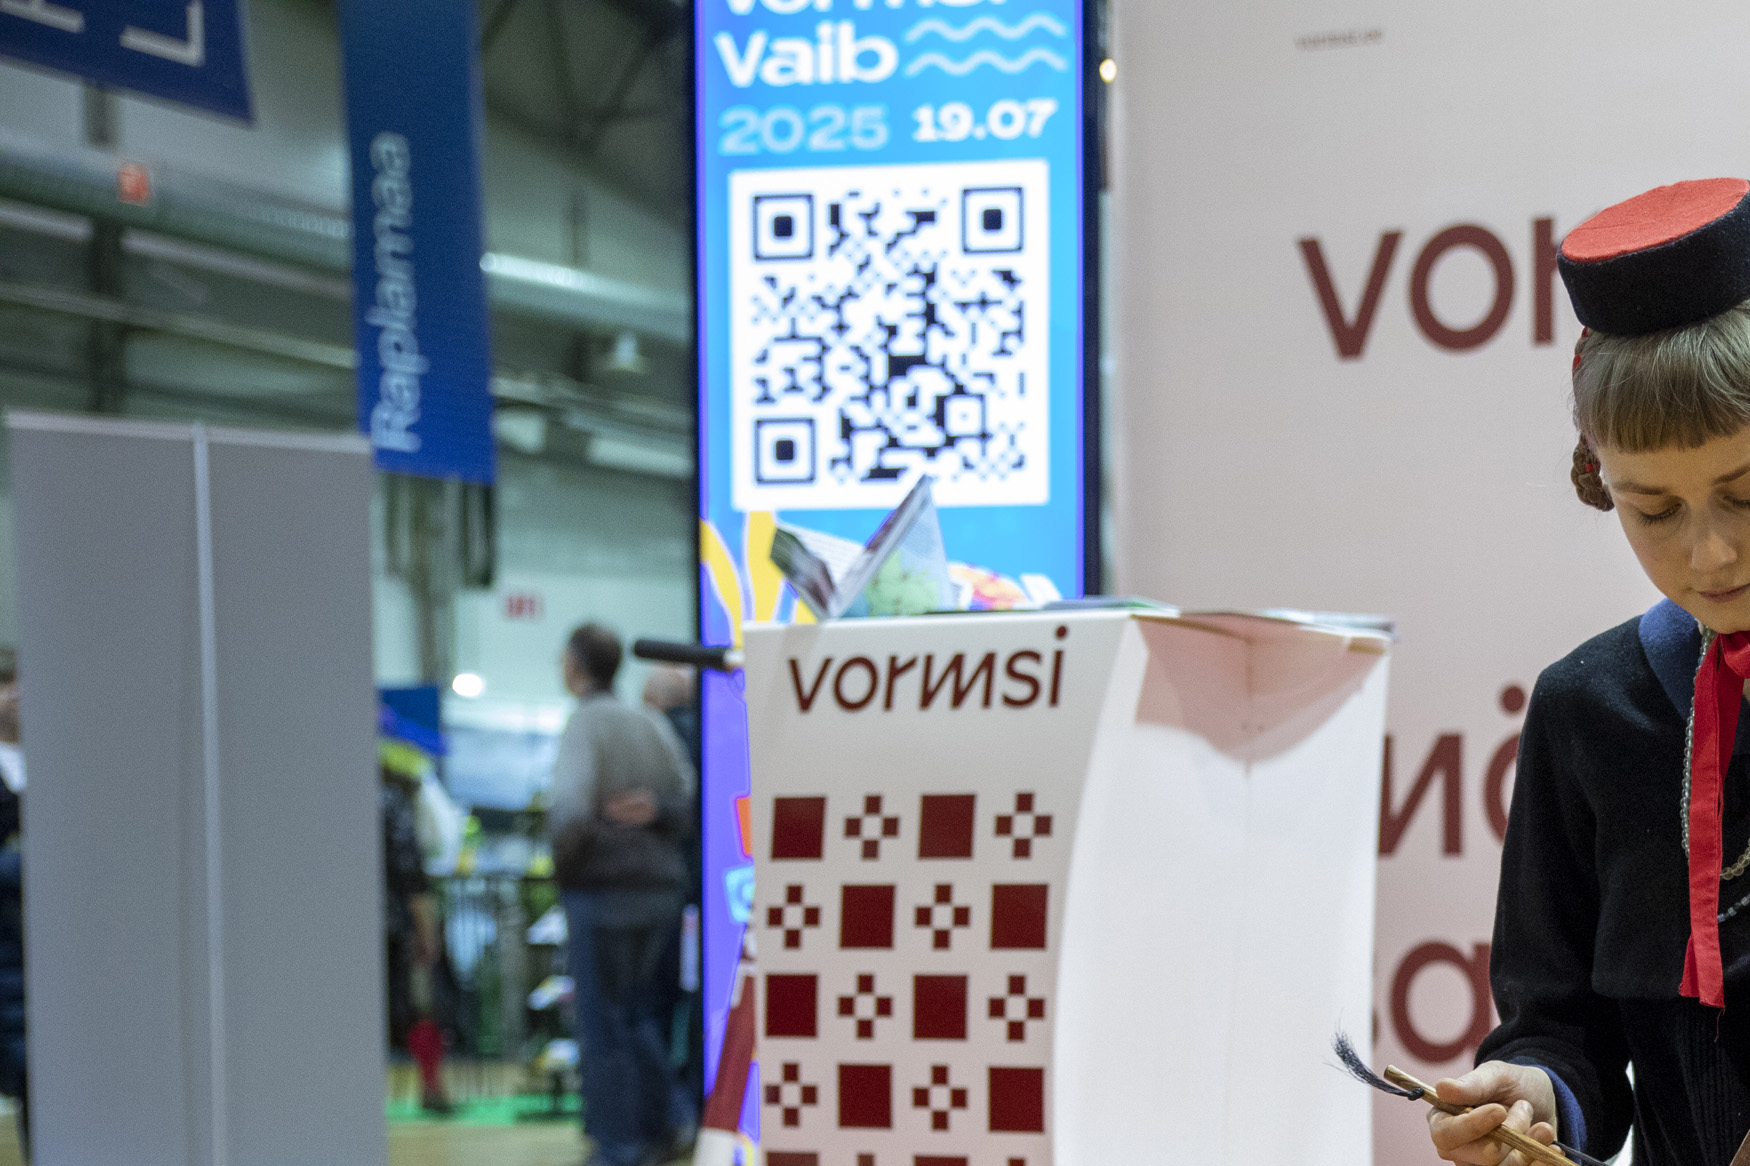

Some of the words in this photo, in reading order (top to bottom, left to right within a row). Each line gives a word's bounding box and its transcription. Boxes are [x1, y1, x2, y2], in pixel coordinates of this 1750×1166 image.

[713, 20, 900, 88] Vaib
[717, 102, 891, 156] 2025
[911, 98, 1059, 142] 19.07
[367, 130, 430, 453] Raplamaa
[788, 624, 1069, 713] vormsi
